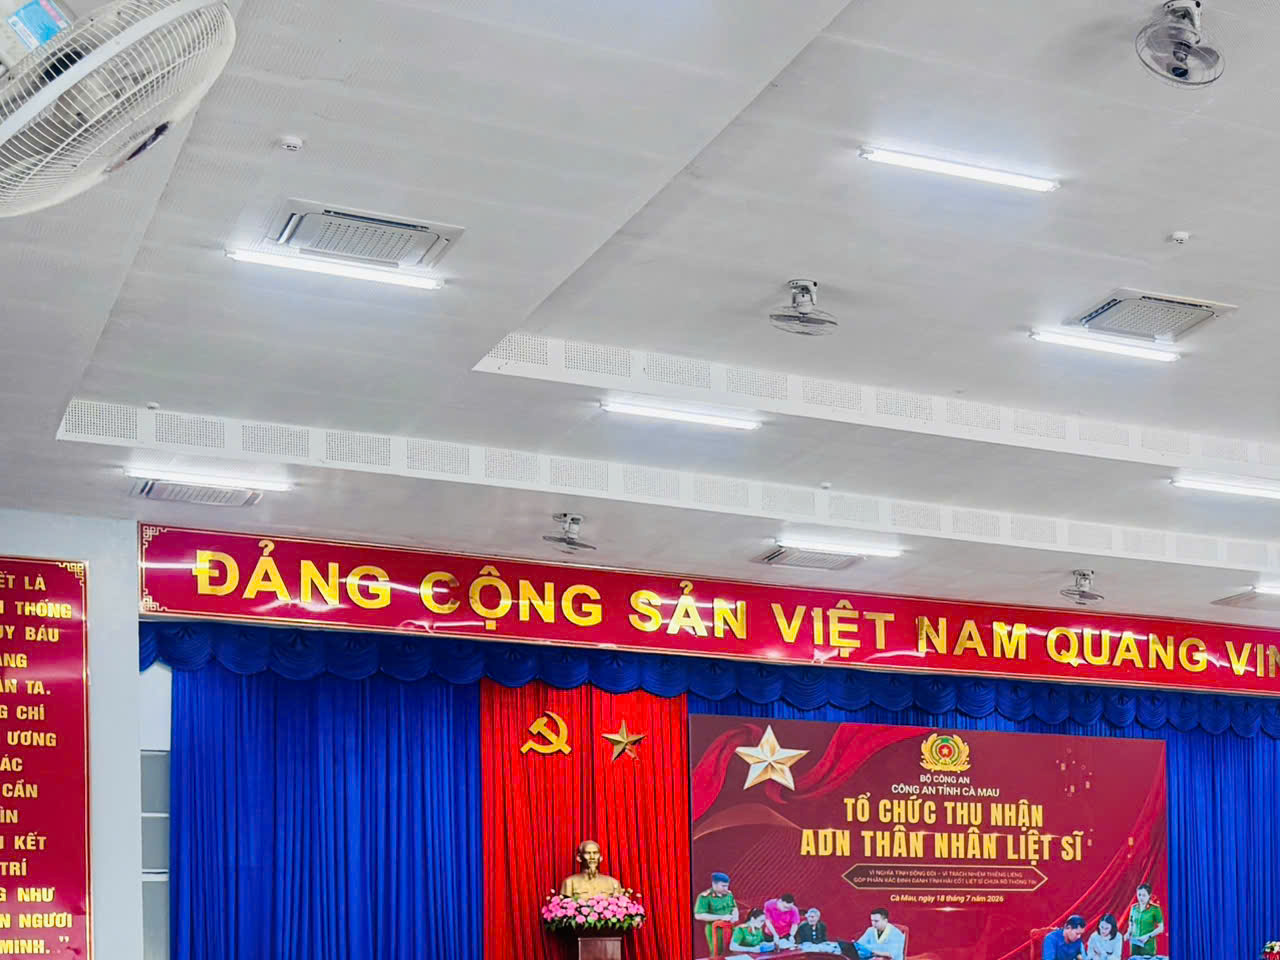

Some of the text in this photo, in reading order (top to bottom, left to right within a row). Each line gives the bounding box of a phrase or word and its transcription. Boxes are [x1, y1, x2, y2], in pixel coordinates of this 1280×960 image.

[24, 573, 47, 591] LÀ
[15, 598, 73, 619] THỐNG
[191, 540, 393, 610] ĐẢNG
[420, 564, 603, 631] CỘNG
[628, 581, 747, 640] SẢN
[771, 599, 895, 659] VIỆT
[914, 616, 1027, 661] NAM
[1046, 626, 1208, 673] QUANG
[25, 624, 60, 642] BÁU
[25, 680, 51, 696] TA.
[16, 704, 45, 721] CHÍ
[7, 730, 57, 747] ƯƠNG
[920, 774, 970, 784] BỘ CÔNG AN
[891, 783, 1000, 797] CÔNG AN TỈNH CÀ MAU
[844, 792, 1044, 831] TỔ CHỨC THU NHẬN
[14, 832, 47, 850] KẾT
[799, 825, 1084, 866] ADN THÂN NHÂN LIỆT SĨ
[0, 858, 27, 876] TRÍ
[17, 887, 56, 902] NHƯ
[890, 894, 900, 902] Cà
[918, 895, 935, 905] ngày
[936, 895, 945, 903] 18
[945, 895, 965, 905] tháng
[971, 895, 985, 904] năm
[987, 896, 1004, 904] 2026
